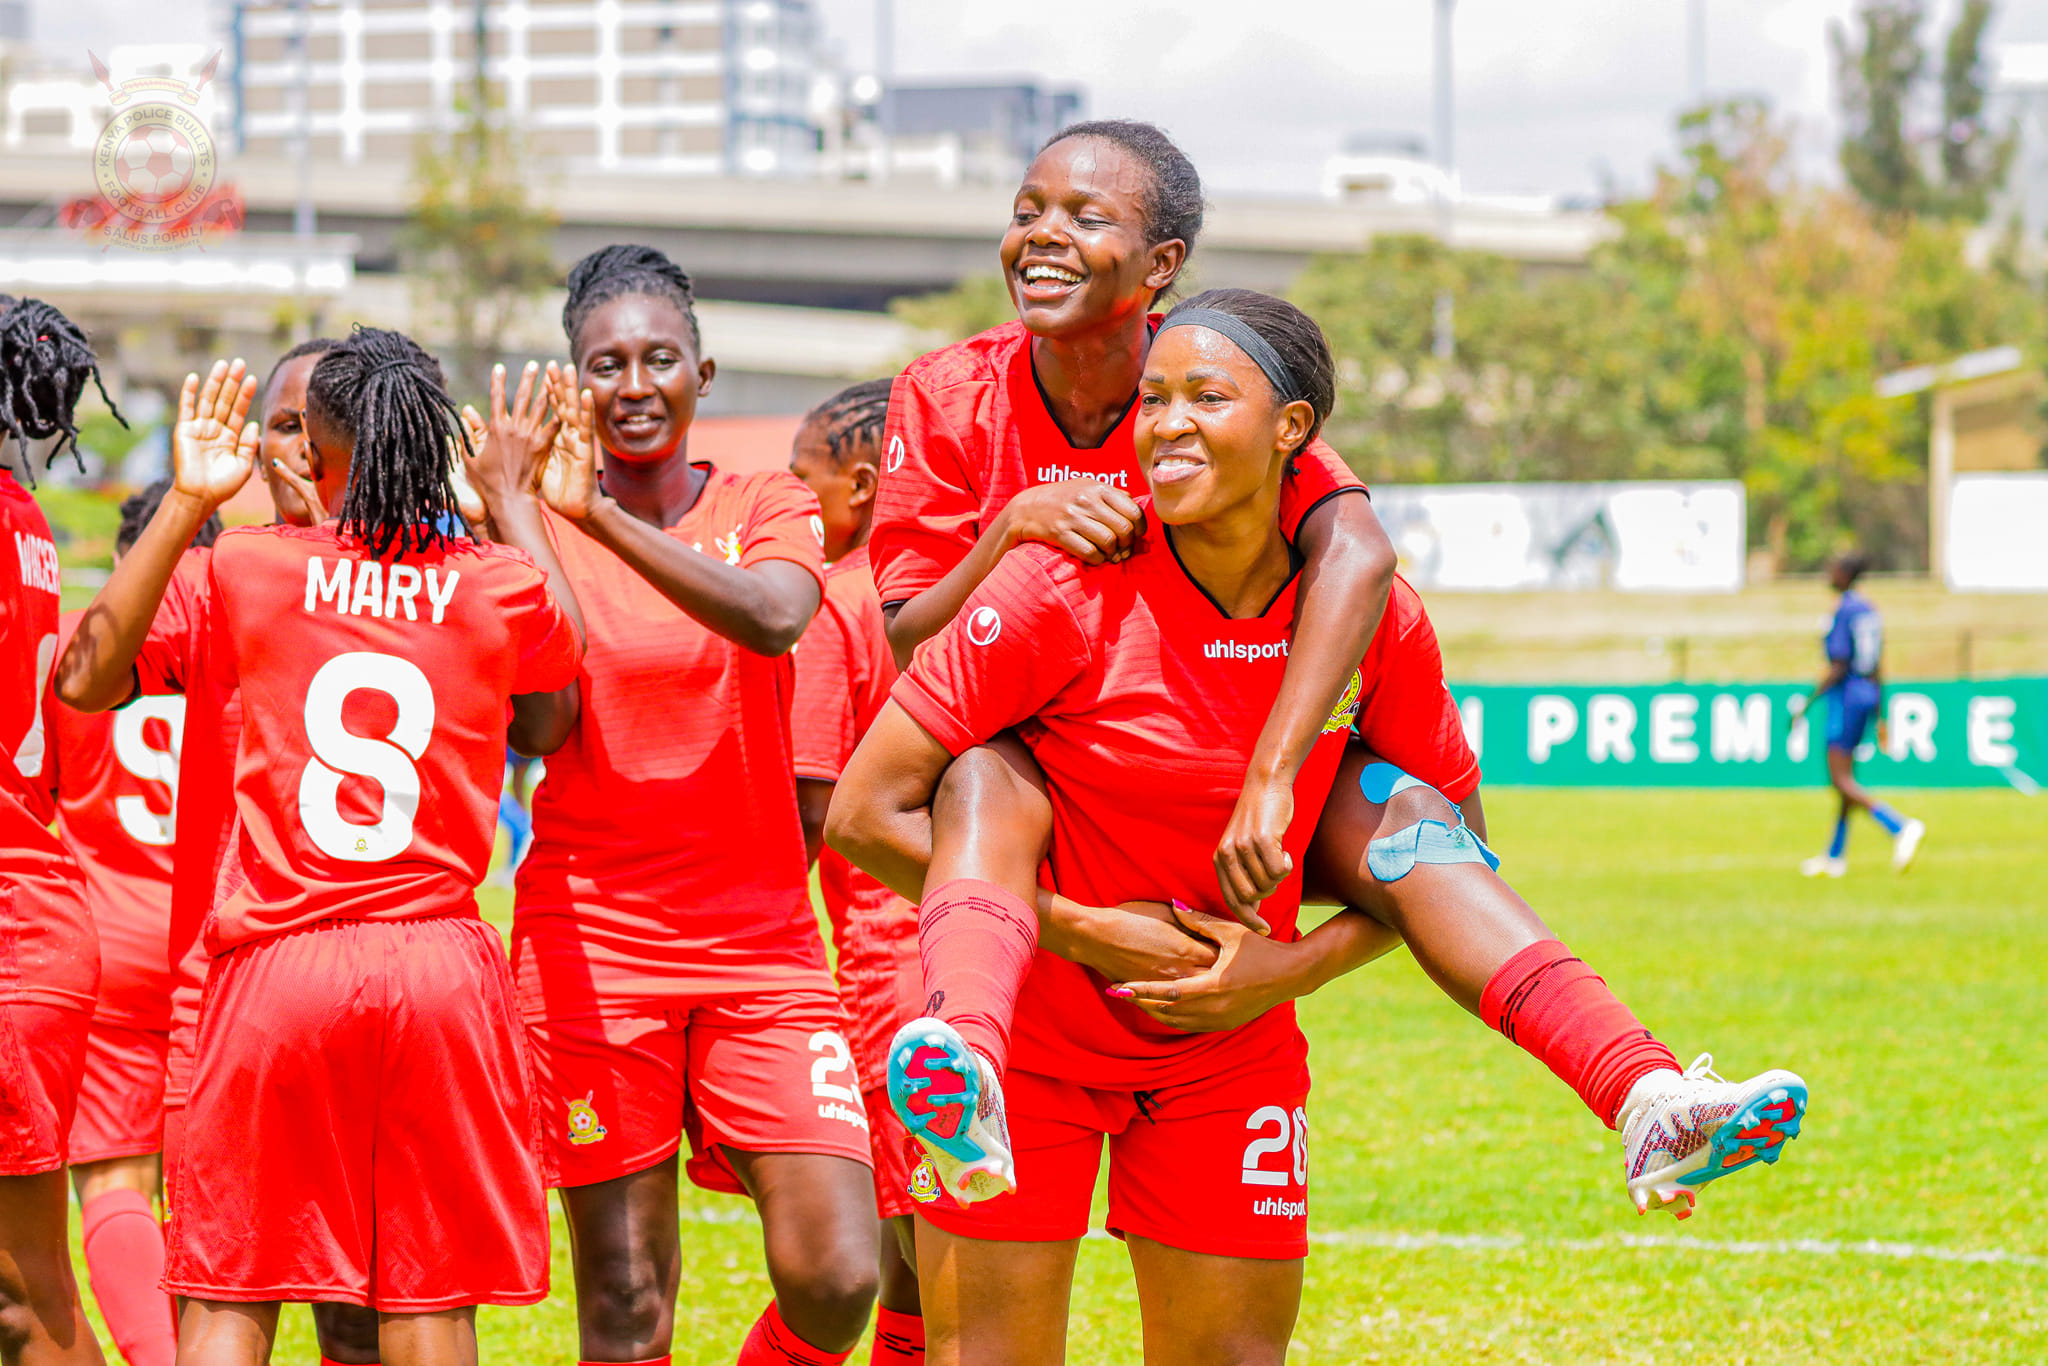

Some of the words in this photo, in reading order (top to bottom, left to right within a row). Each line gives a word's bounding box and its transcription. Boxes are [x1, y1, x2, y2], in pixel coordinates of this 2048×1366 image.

[304, 556, 460, 624] MARY
[1203, 639, 1289, 663] uhlsport
[299, 651, 436, 862] 8
[1527, 693, 2019, 766] PREMIRE
[113, 694, 187, 845] 9
